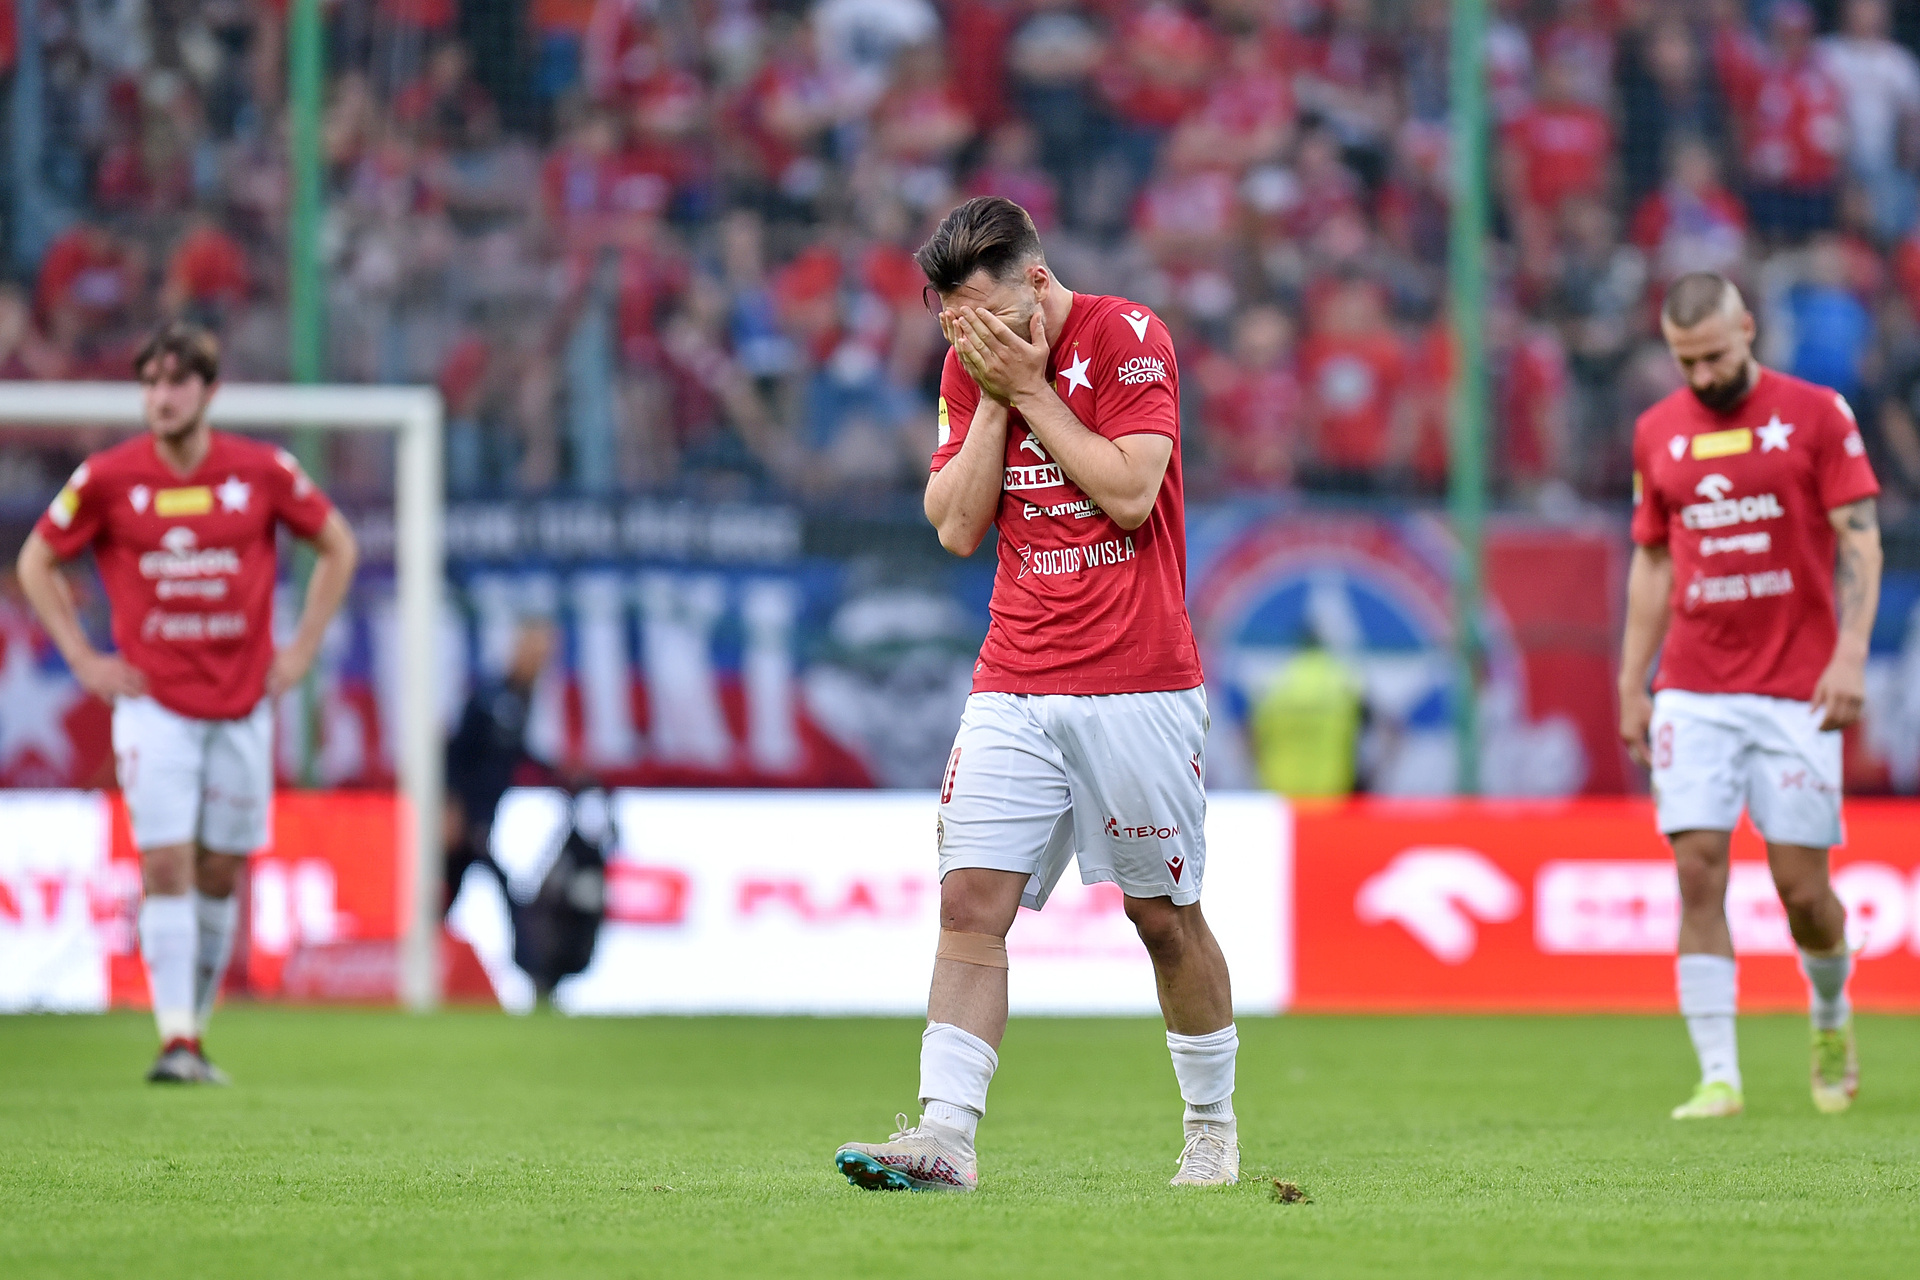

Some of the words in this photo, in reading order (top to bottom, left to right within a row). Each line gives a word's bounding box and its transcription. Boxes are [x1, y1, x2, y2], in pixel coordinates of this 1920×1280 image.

[1117, 356, 1165, 377] NOWAK
[1124, 372, 1163, 385] MOSTY
[1004, 466, 1061, 486] ORLEN
[1032, 547, 1080, 575] SOCIOS
[1082, 536, 1136, 568] WISŁA
